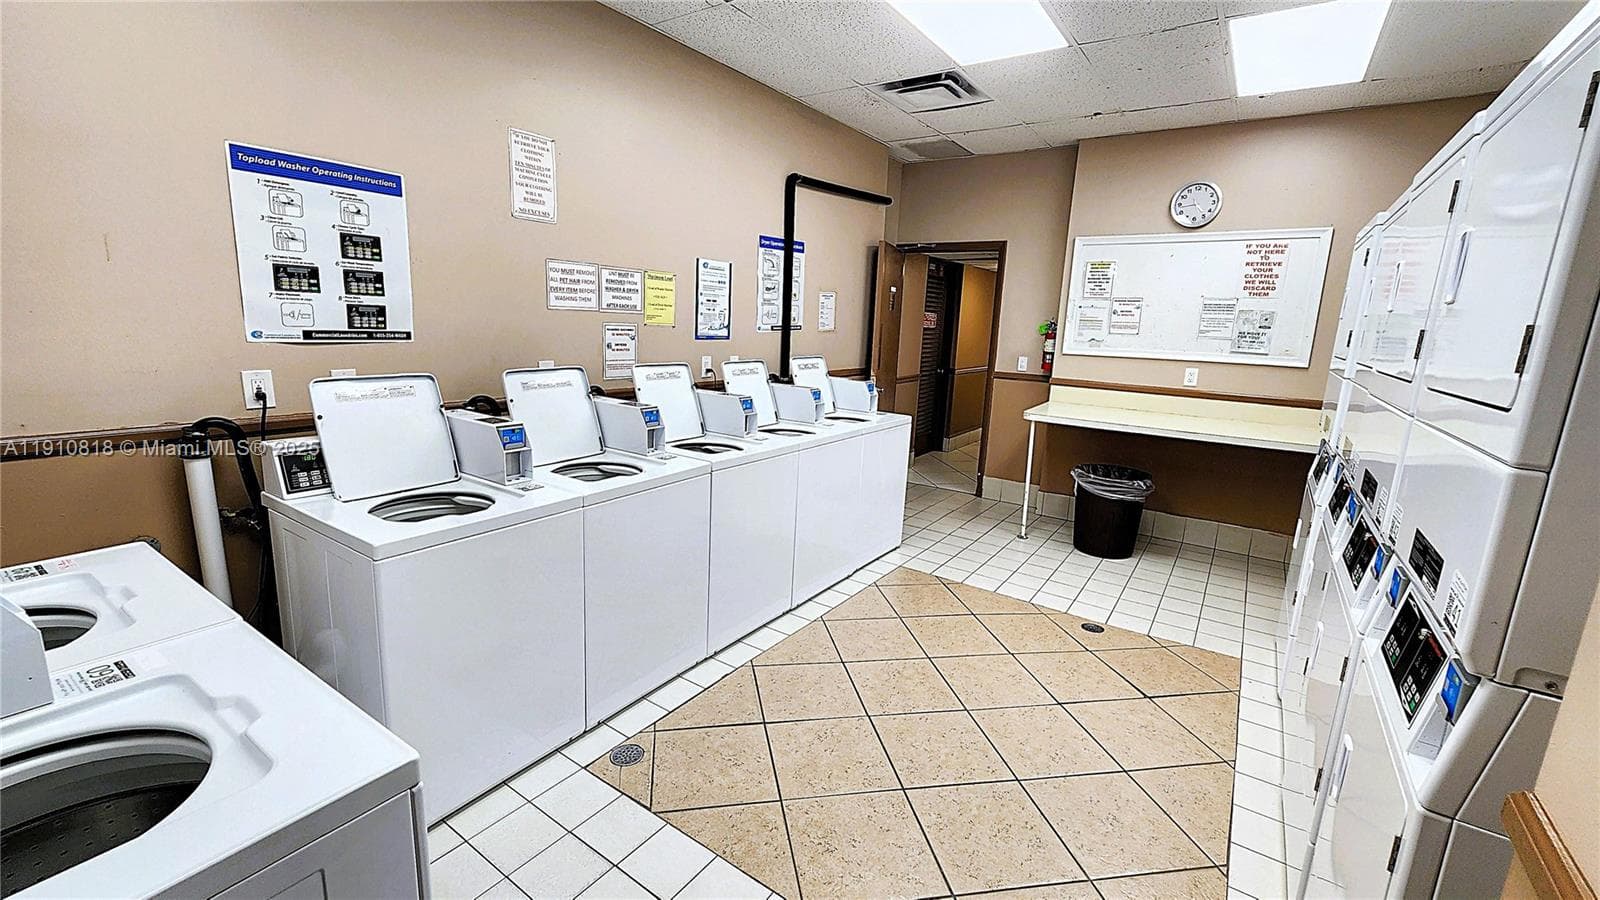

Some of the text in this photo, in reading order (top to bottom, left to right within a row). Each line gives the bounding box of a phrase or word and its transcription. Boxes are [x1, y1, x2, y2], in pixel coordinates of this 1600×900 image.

[520, 148, 545, 157] CLOTHING
[237, 153, 397, 188] Topload Washer Operating Instructions
